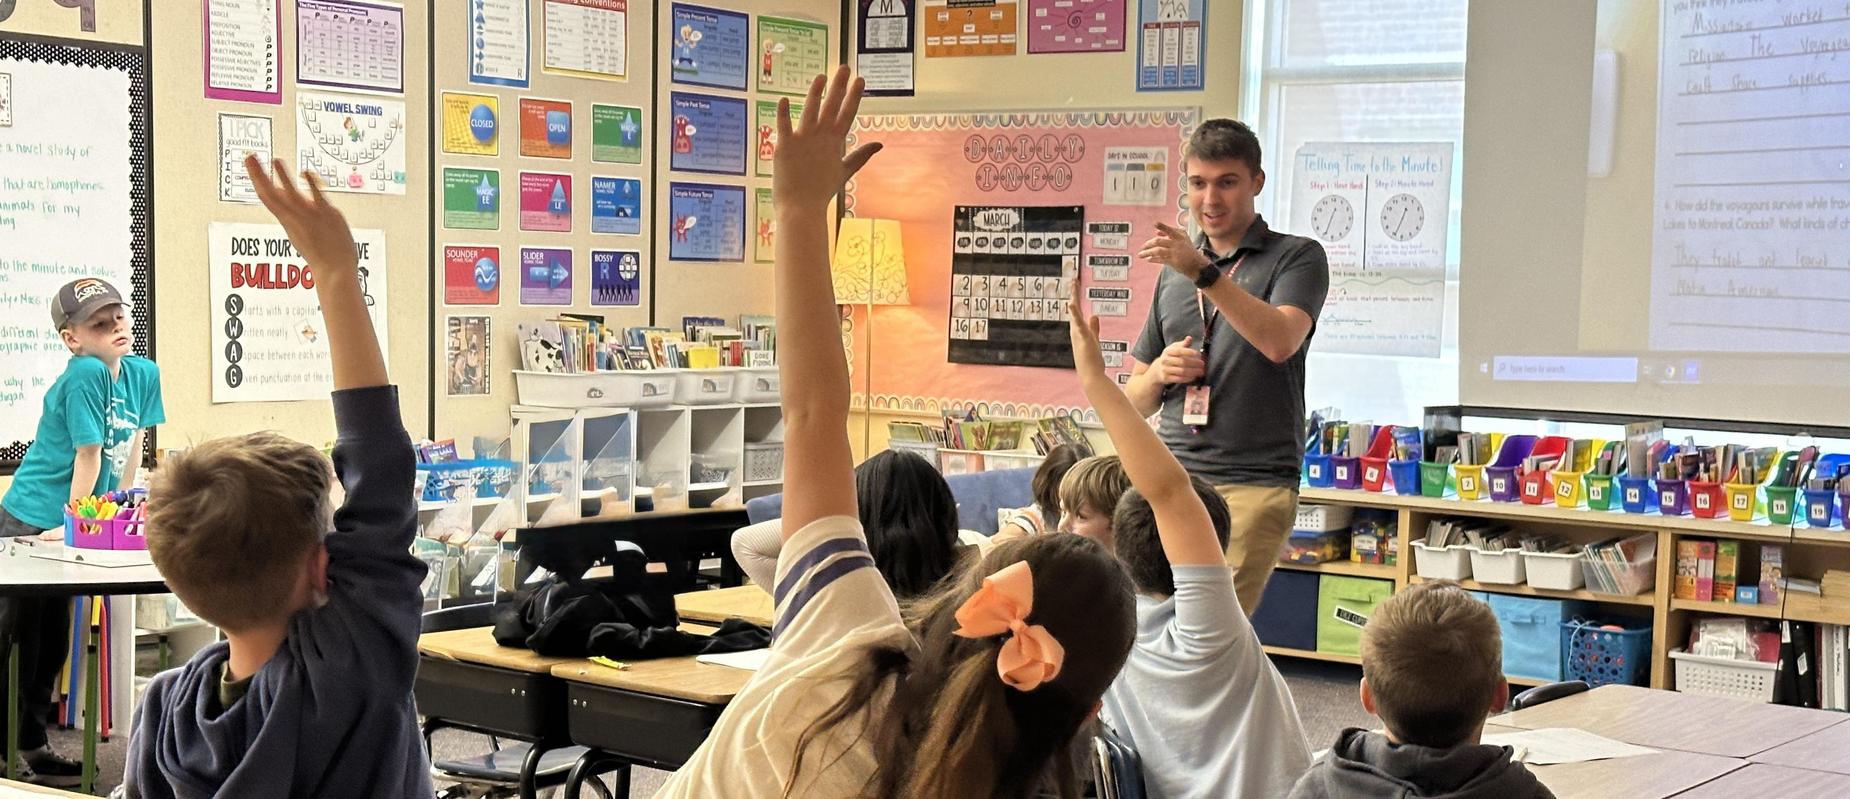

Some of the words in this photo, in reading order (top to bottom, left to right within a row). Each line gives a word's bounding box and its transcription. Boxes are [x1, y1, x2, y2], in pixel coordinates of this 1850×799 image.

[323, 101, 352, 114] VOWEL
[355, 104, 382, 117] SWING
[471, 119, 494, 128] CLOSED
[549, 124, 566, 133] OPEN
[16, 143, 42, 154] novel
[972, 138, 1076, 160] DAILY
[1301, 154, 1340, 176] Telling
[1343, 154, 1366, 173] Time
[983, 168, 1065, 188] INFO
[984, 212, 1010, 226] MARCH
[232, 236, 260, 256] DOES
[264, 239, 292, 258] YOUR
[446, 249, 478, 259] SOUNDER
[523, 252, 544, 260] SLIDER
[594, 254, 614, 263] BOSSY
[1072, 257, 1077, 270] 1
[230, 262, 316, 290] BULLDO
[962, 277, 970, 290] 2
[982, 278, 988, 290] 3
[1000, 278, 1007, 291] 4
[1018, 278, 1024, 291] 5
[1034, 278, 1042, 292] 6
[1054, 278, 1060, 292] 7
[963, 298, 970, 312] 9
[975, 298, 988, 312] 10
[995, 299, 1006, 312] 11
[1012, 300, 1022, 314] 12
[1030, 300, 1042, 314] 13
[1047, 300, 1058, 313] 14
[955, 318, 968, 332] 16
[976, 320, 986, 333] 17
[1312, 468, 1316, 476] 4
[1494, 482, 1504, 490] 10
[1528, 485, 1536, 493] 11
[1561, 484, 1570, 493] 12
[1591, 489, 1600, 497] 13
[1628, 491, 1638, 500] 14
[1664, 494, 1672, 502] 15
[1698, 496, 1708, 505] 16
[1736, 498, 1746, 506] 17
[1775, 503, 1784, 512] 18
[1812, 508, 1823, 516] 19
